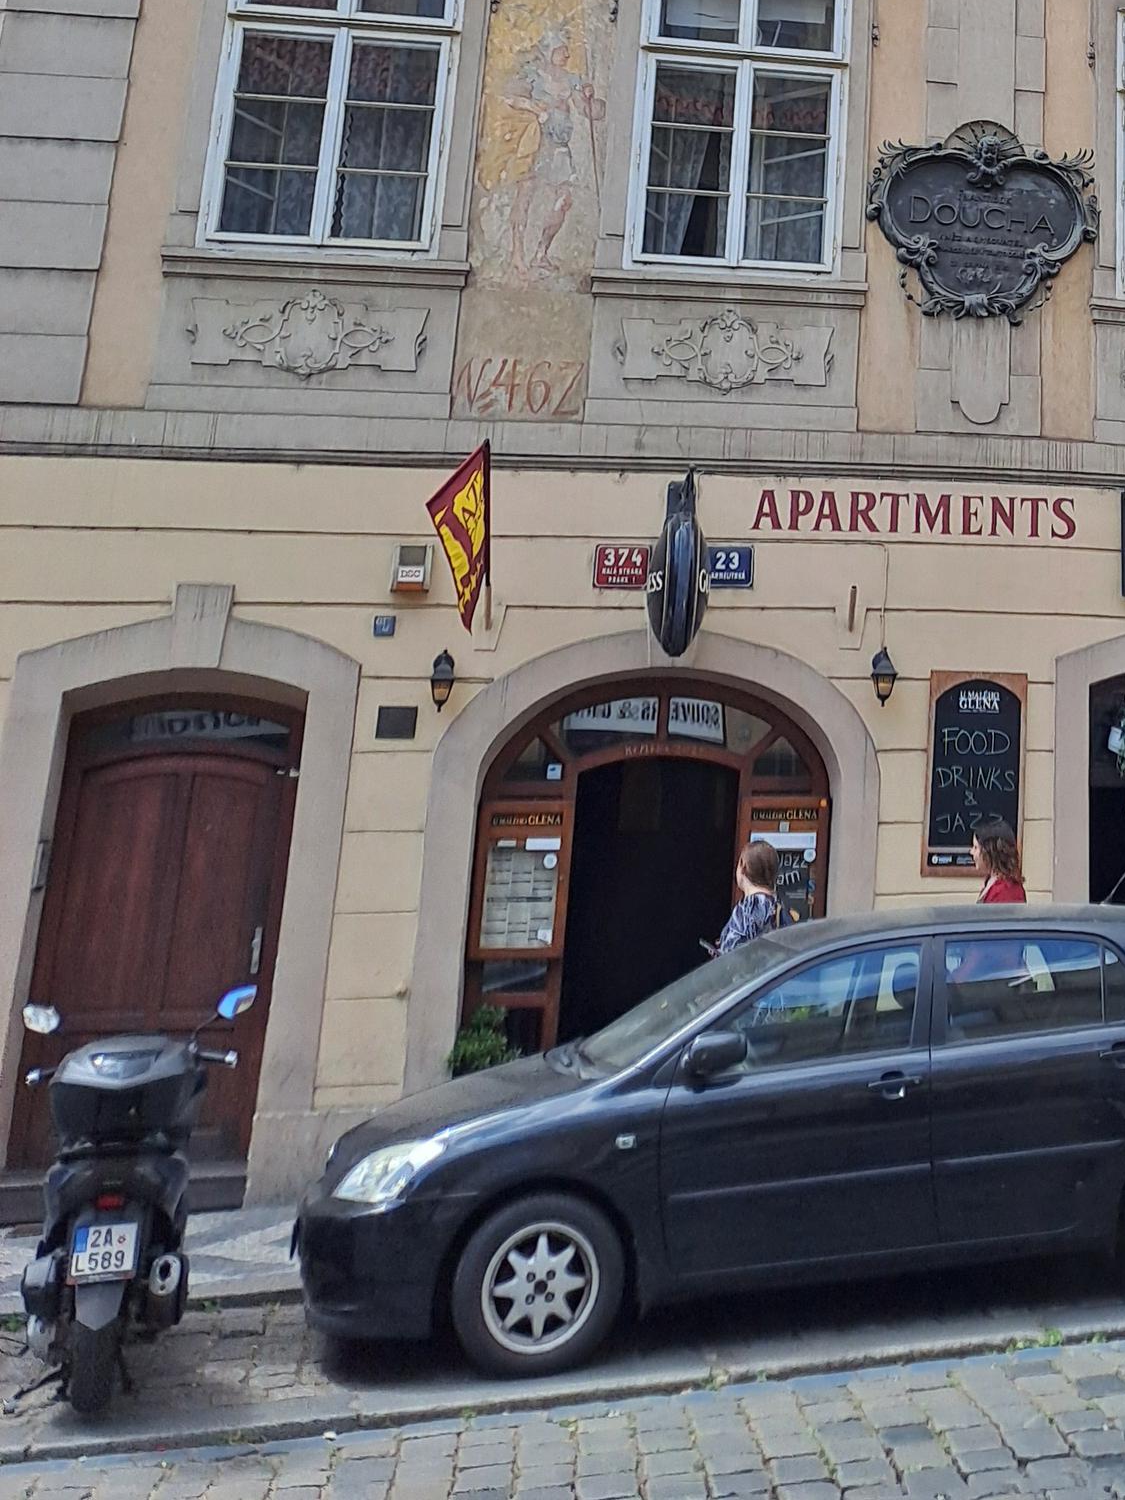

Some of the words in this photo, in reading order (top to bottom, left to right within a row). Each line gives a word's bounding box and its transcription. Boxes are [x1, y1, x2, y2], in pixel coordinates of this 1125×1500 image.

[909, 196, 1056, 236] DOUCHA
[750, 489, 1077, 540] APARTMENTS
[603, 548, 643, 567] 374
[715, 551, 740, 570] 23
[942, 727, 1011, 756] FOOD
[936, 766, 1015, 792] DRINKS
[74, 1250, 126, 1273] L589
